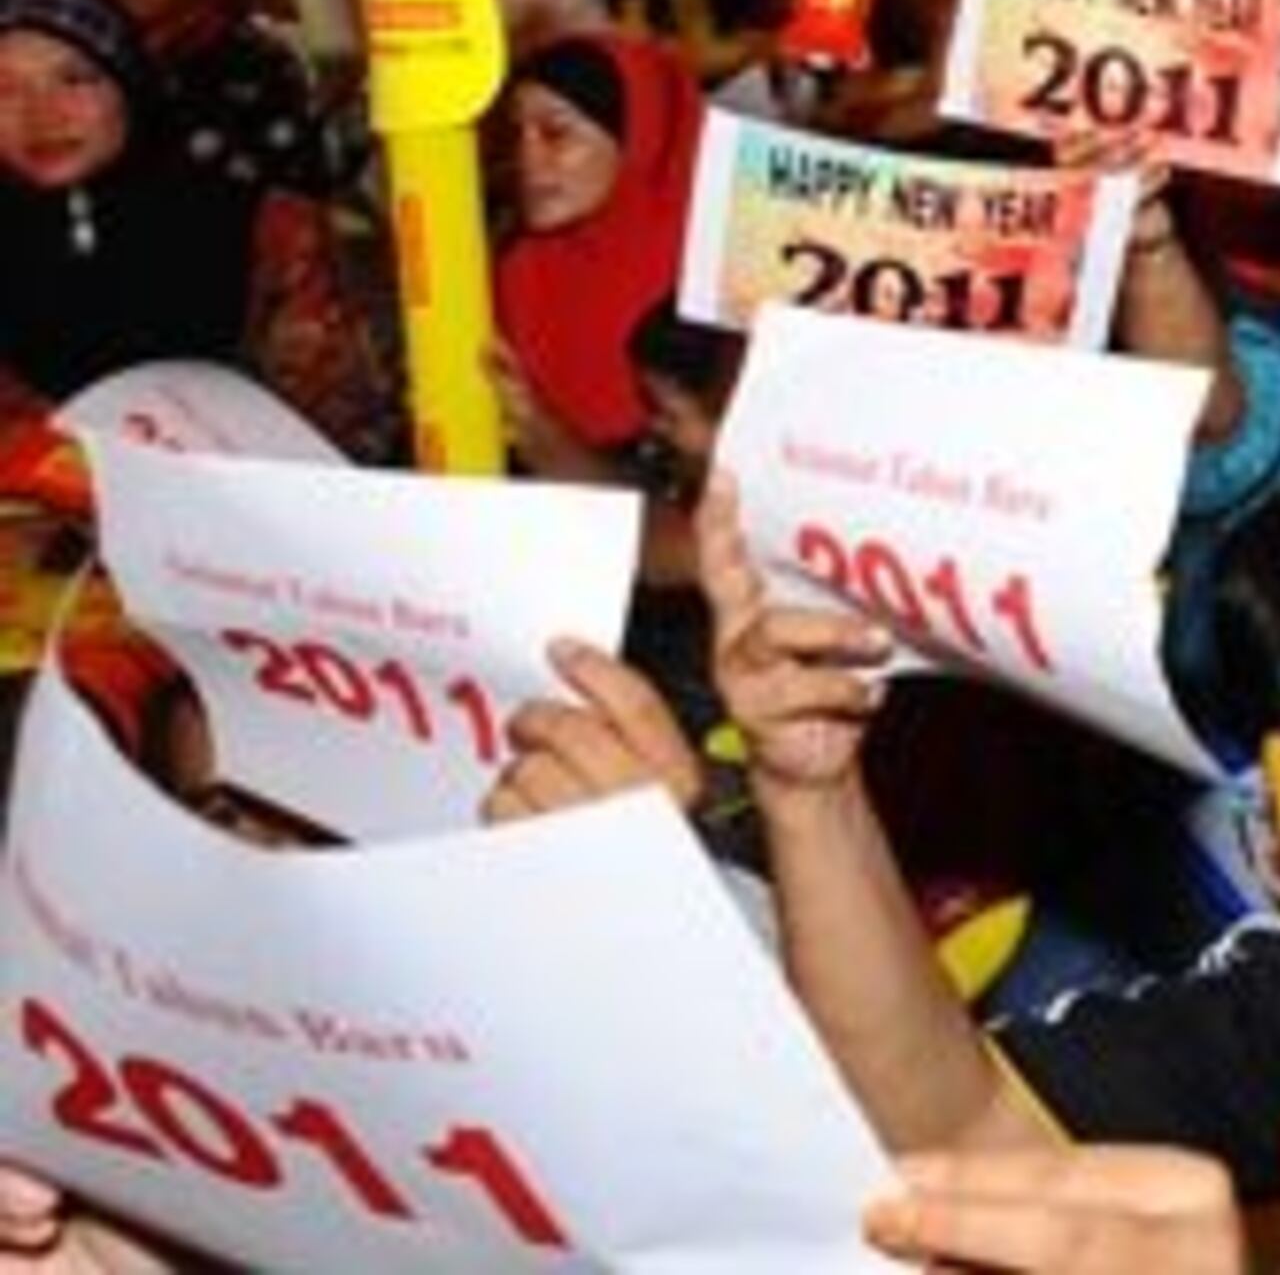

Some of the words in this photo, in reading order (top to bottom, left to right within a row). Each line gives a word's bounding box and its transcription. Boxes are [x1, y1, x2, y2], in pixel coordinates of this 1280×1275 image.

[1018, 29, 1241, 146] 2011
[767, 147, 875, 214] HAPPY
[890, 175, 961, 232] NEW
[984, 189, 1060, 236] YEAR
[780, 237, 1029, 331] 2011
[796, 523, 1054, 675] 2011
[217, 627, 499, 765] 2011
[20, 994, 573, 1250] 2011
